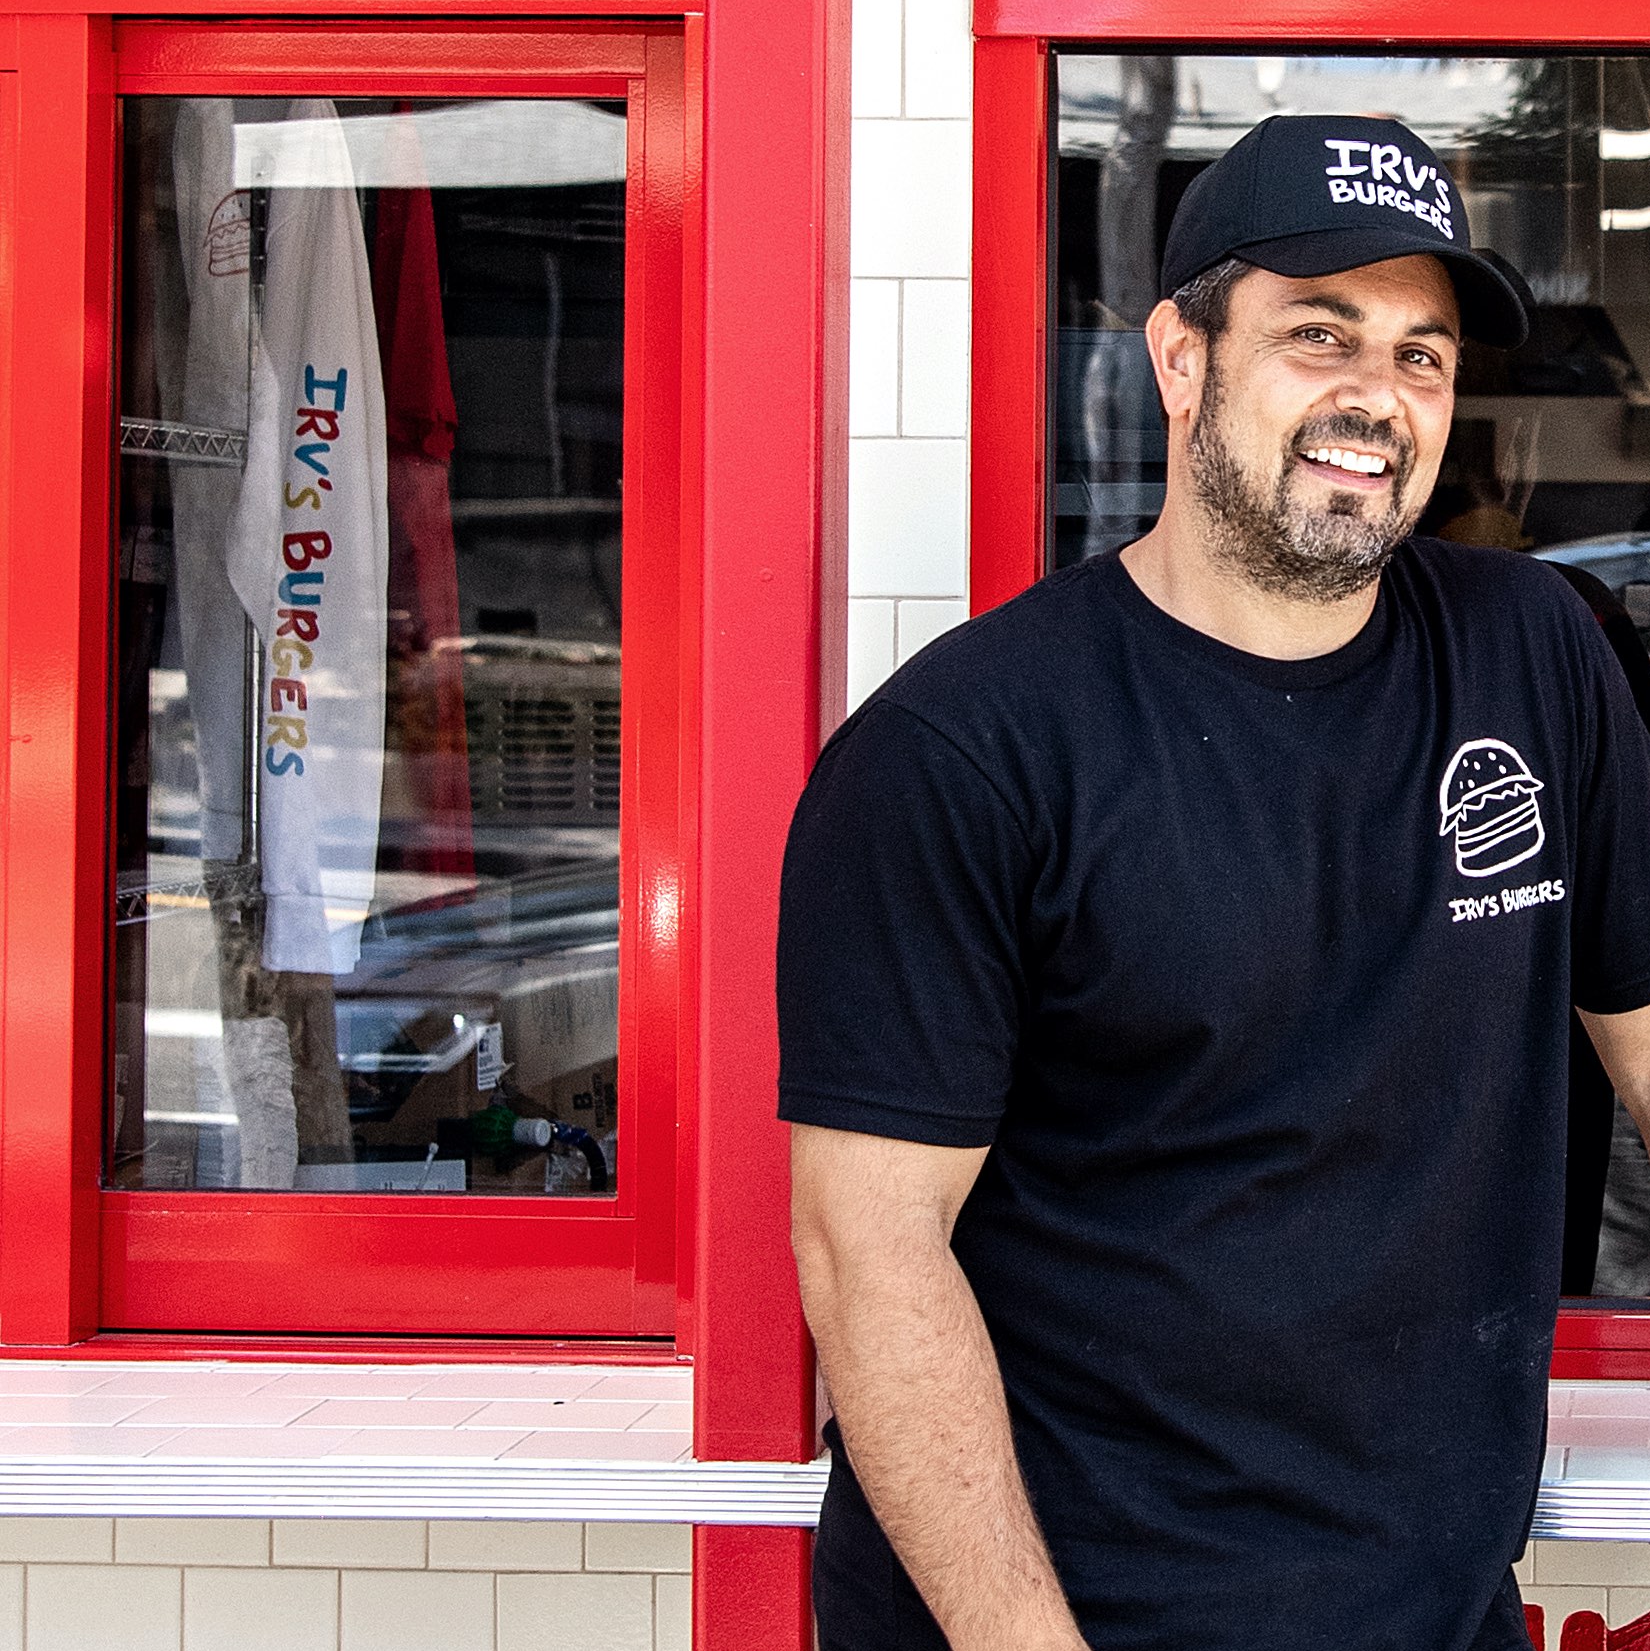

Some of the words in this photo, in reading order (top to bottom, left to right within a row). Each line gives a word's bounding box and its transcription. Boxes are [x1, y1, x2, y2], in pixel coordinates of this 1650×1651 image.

[1324, 138, 1451, 214] IRV'S
[1329, 177, 1453, 239] BURGERS
[282, 363, 348, 512] IRV'S
[265, 530, 333, 777] BURGERS
[1449, 896, 1499, 922] IRV'S
[1501, 880, 1565, 913] BURGERS
